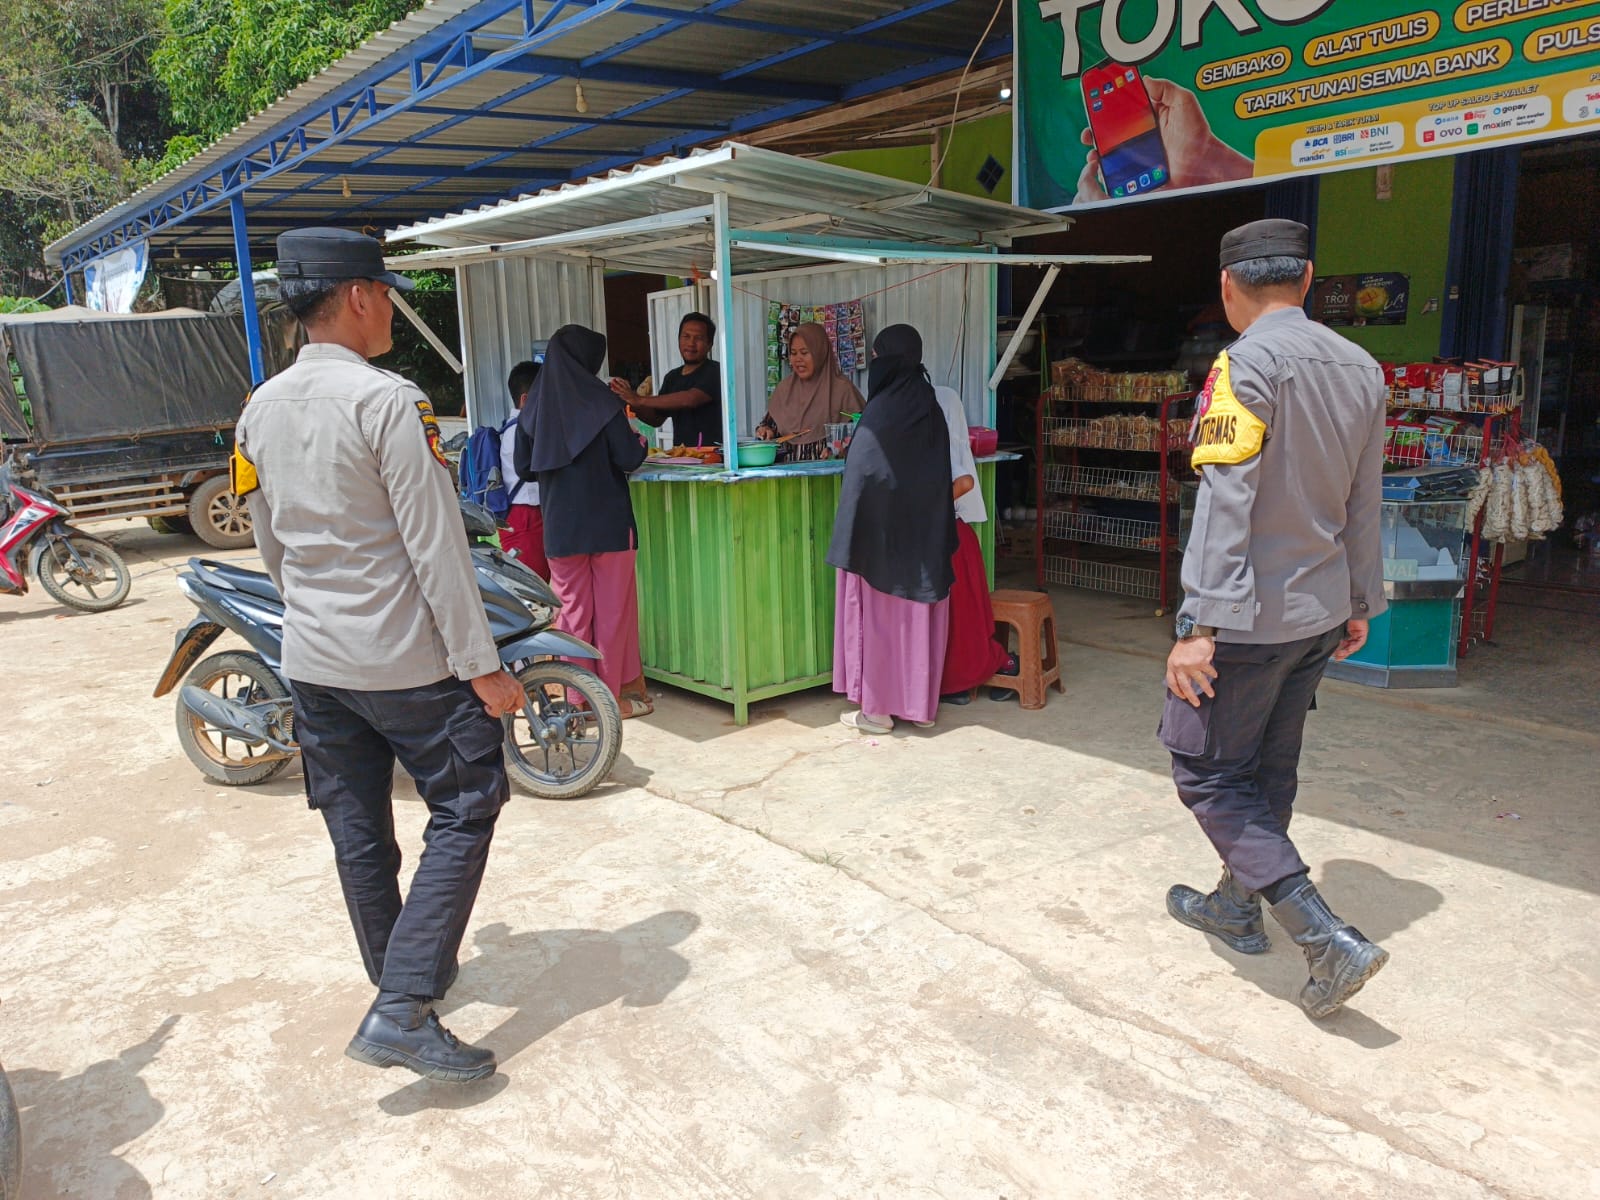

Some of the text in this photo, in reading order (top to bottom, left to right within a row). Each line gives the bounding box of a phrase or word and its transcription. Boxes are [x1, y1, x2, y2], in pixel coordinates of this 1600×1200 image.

[1039, 0, 1332, 78] TOK
[1314, 20, 1427, 60] ALAT TULIS
[1202, 52, 1286, 84] SEMBAKO
[1244, 46, 1499, 114] TARIK TUNAI SEMUA BANK
[1502, 103, 1527, 115] gopay
[1370, 126, 1388, 138] BNI
[1440, 128, 1462, 138] OVO
[1483, 121, 1510, 133] maxim
[1325, 294, 1349, 304] TROY
